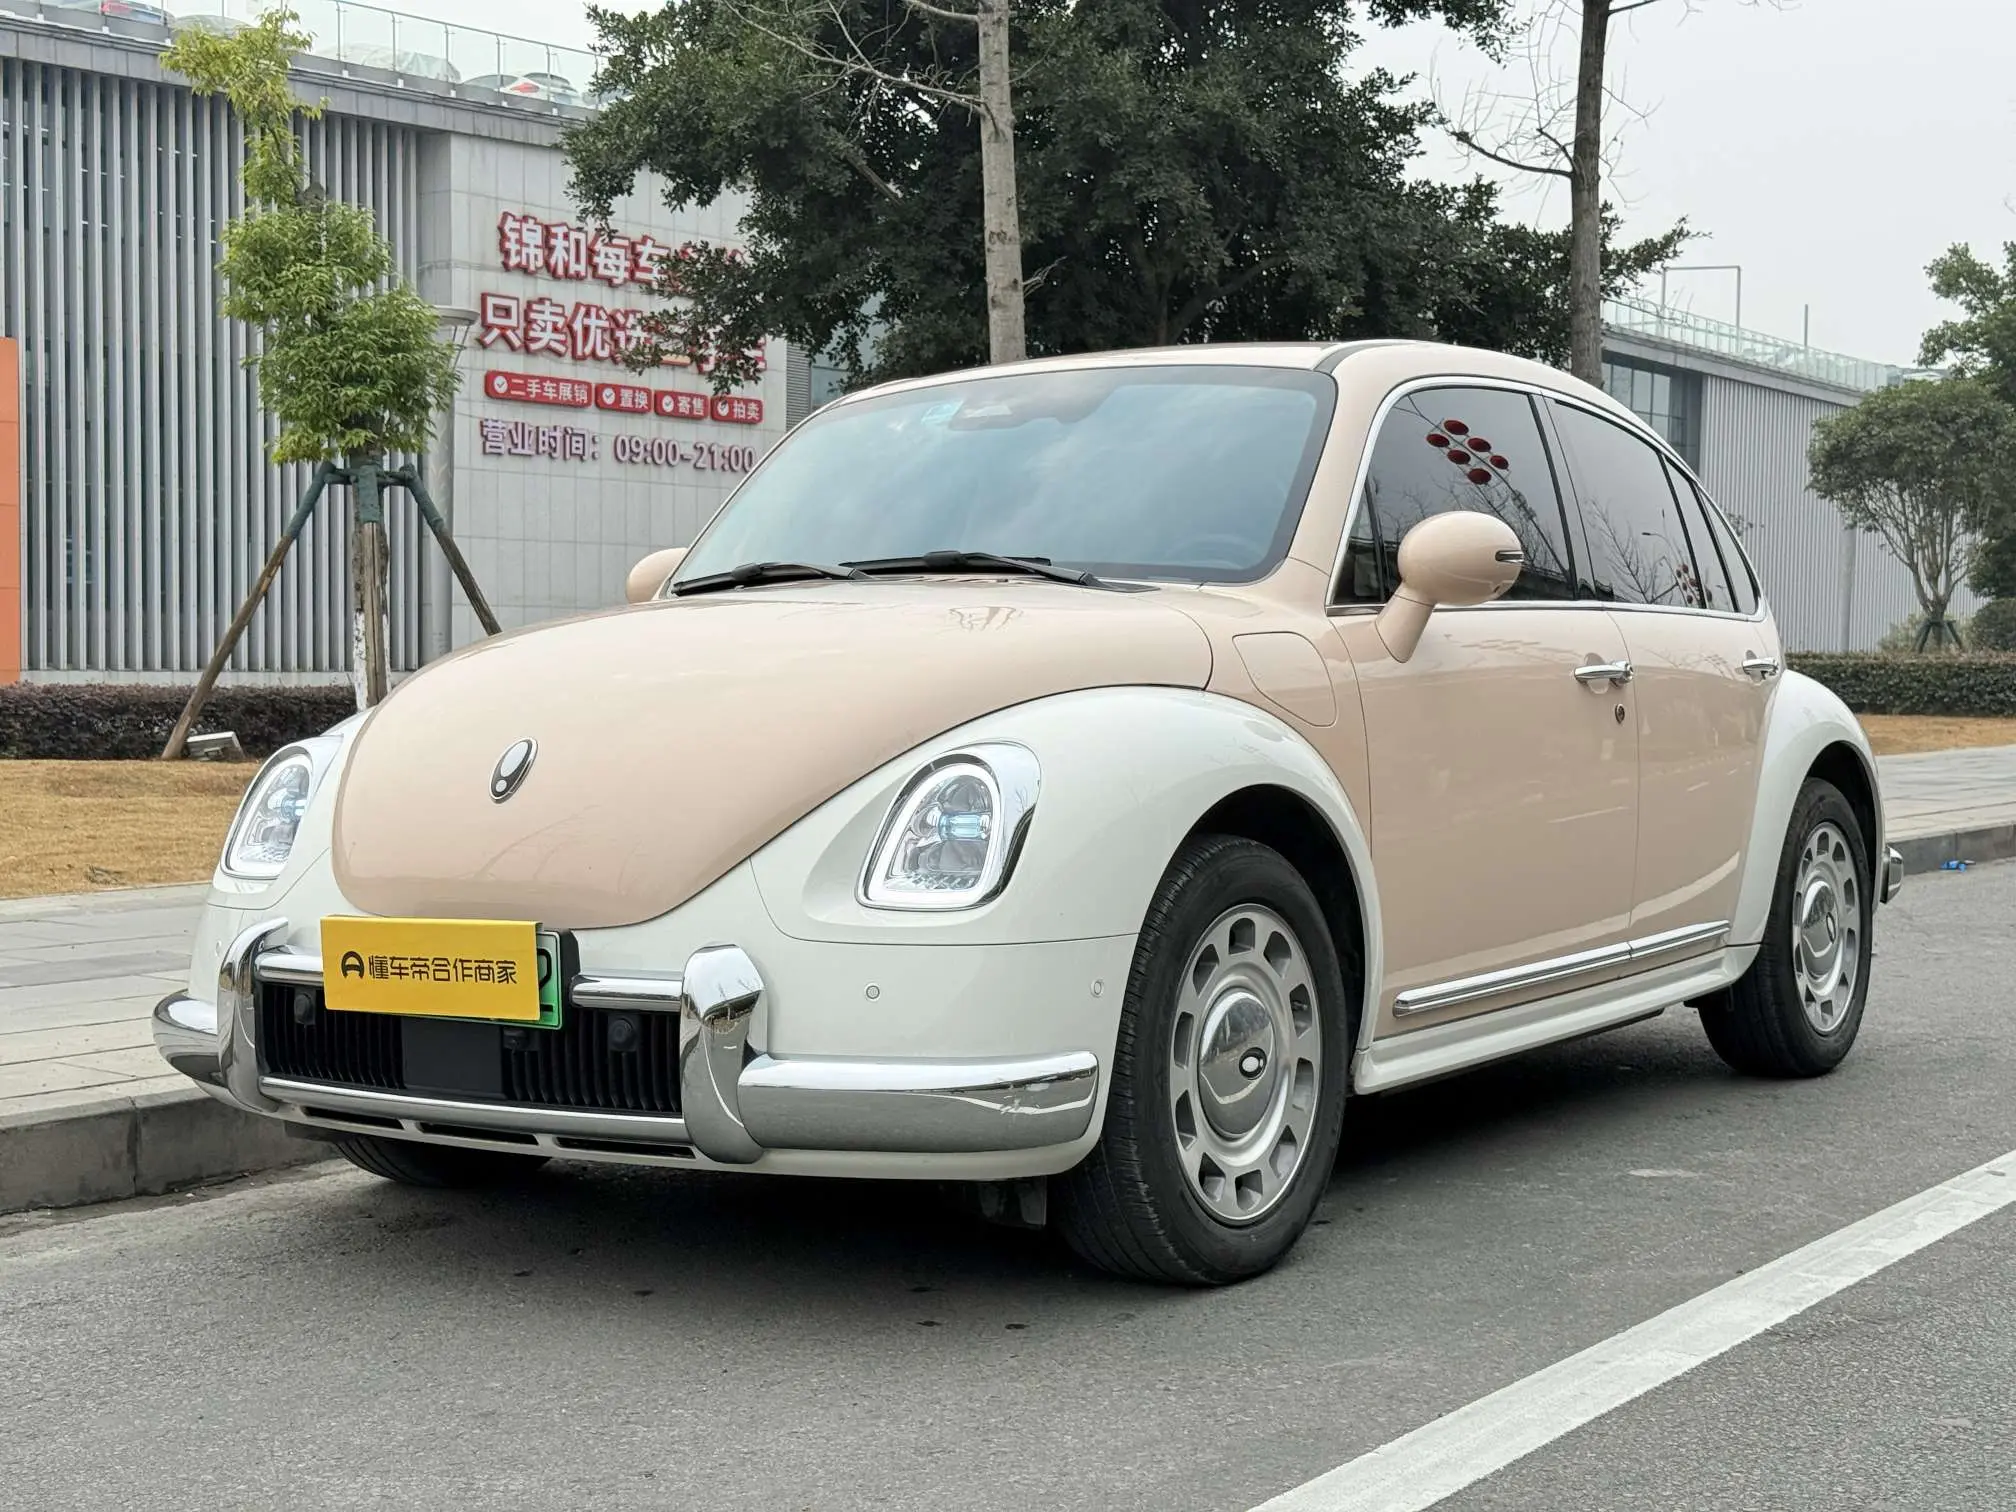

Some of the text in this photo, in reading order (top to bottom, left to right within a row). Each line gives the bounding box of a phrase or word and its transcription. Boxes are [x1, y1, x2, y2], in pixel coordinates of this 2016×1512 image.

[499, 212, 755, 296] 锦和每车
[510, 378, 760, 420] 二手车展销 置换 寄售 拍卖
[614, 434, 756, 473] 09:00-21:00
[368, 955, 518, 985] 懂车帝合作商家
